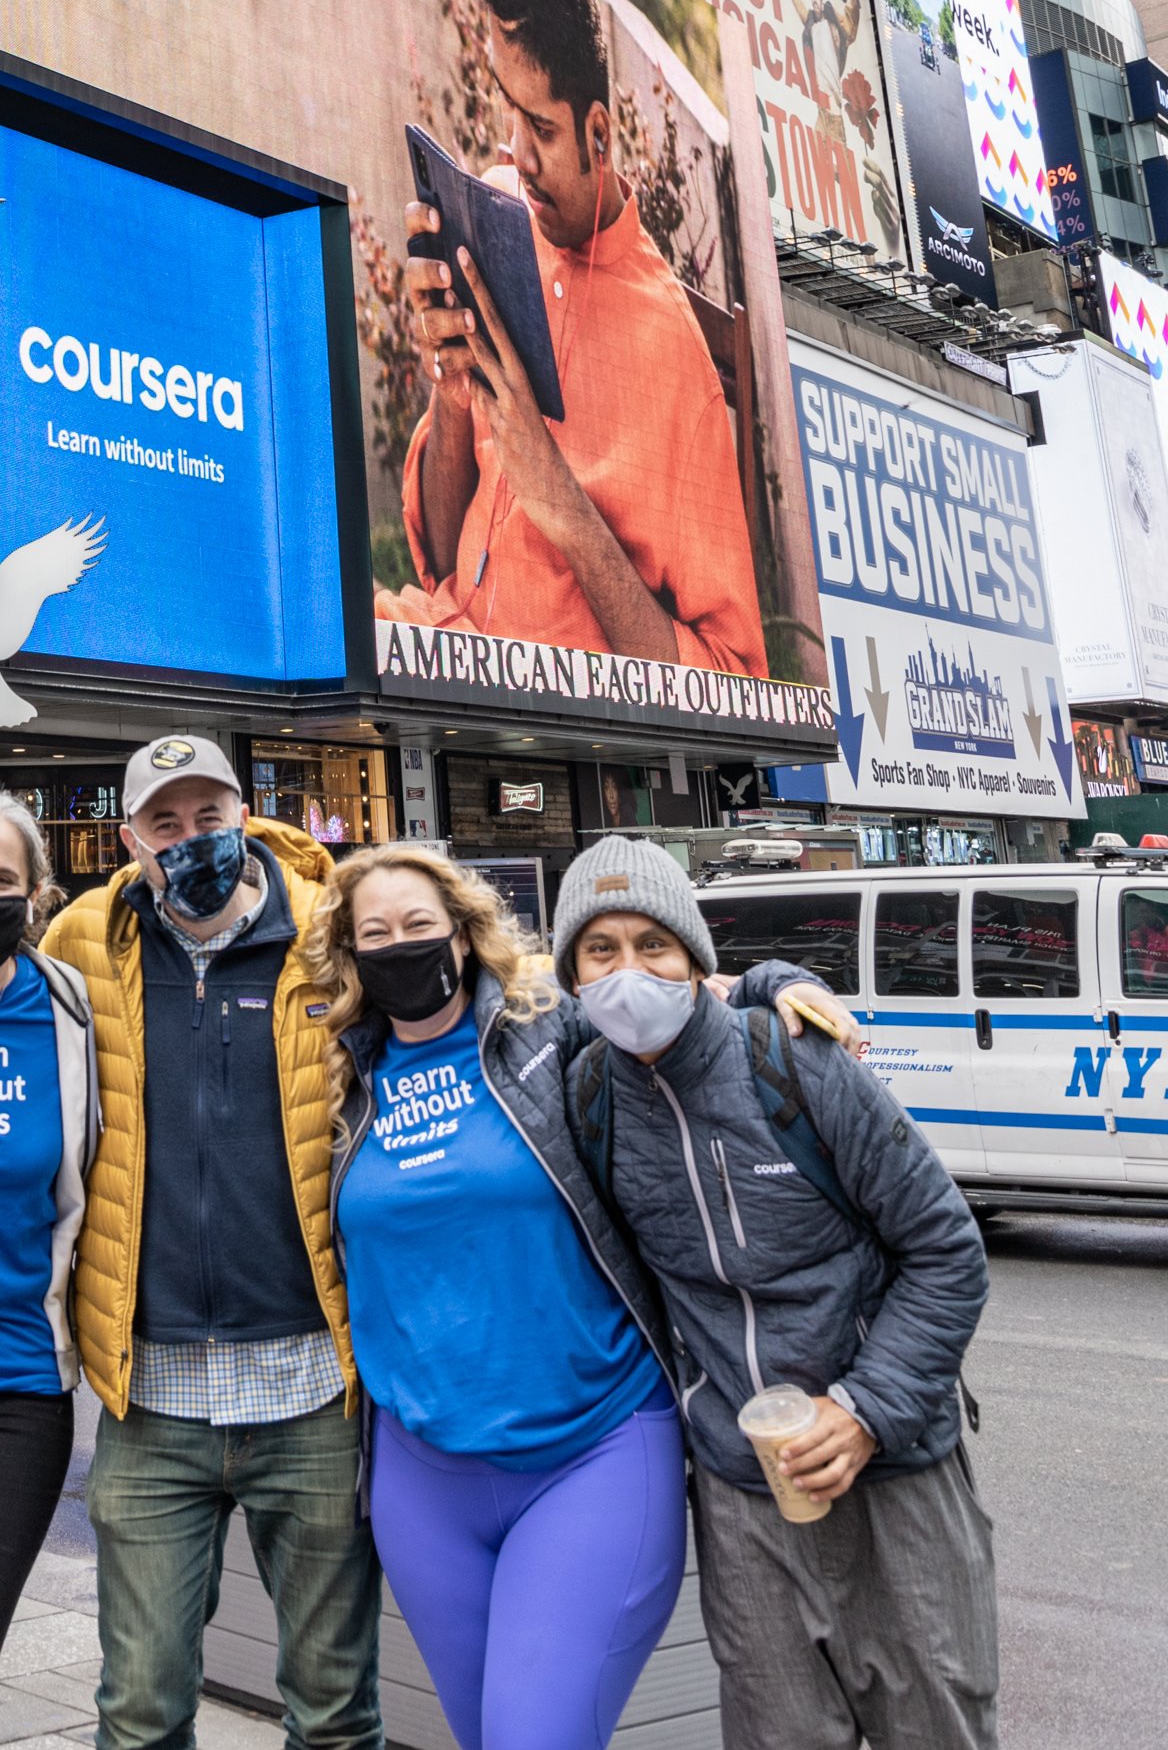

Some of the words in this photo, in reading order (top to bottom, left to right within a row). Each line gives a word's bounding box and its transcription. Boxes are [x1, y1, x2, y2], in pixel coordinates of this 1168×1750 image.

[928, 235, 986, 278] ARCIMOTO
[18, 325, 246, 432] coursera
[47, 419, 101, 459] Learn
[103, 434, 175, 477] without
[176, 452, 226, 485] limits
[800, 377, 939, 495] SUPPORT
[939, 430, 1031, 523] SMALL
[807, 456, 1047, 631] BUSINESS
[1064, 652, 1127, 666] MANUFACTORY
[1075, 642, 1113, 654] CRYSTAL
[384, 623, 577, 698] AMERICAN
[586, 652, 680, 709] EAGLE
[684, 668, 836, 731] OUTFITTERS
[904, 678, 968, 739] GRAND
[965, 687, 1014, 743] SLAM
[954, 740, 964, 752] NEW
[964, 741, 978, 753] YORK
[871, 757, 906, 789] Sports
[906, 760, 925, 787] Fan
[926, 763, 951, 793] Shop
[956, 765, 977, 791] NYC
[977, 767, 1011, 798] Apparel
[1016, 771, 1057, 798] Souvenirs
[517, 1041, 557, 1082] coursera
[858, 1041, 919, 1057] COURTESY
[381, 1064, 458, 1104] Learn
[1064, 1046, 1168, 1100] NY
[373, 1079, 476, 1138] without
[398, 1148, 446, 1170] coursera
